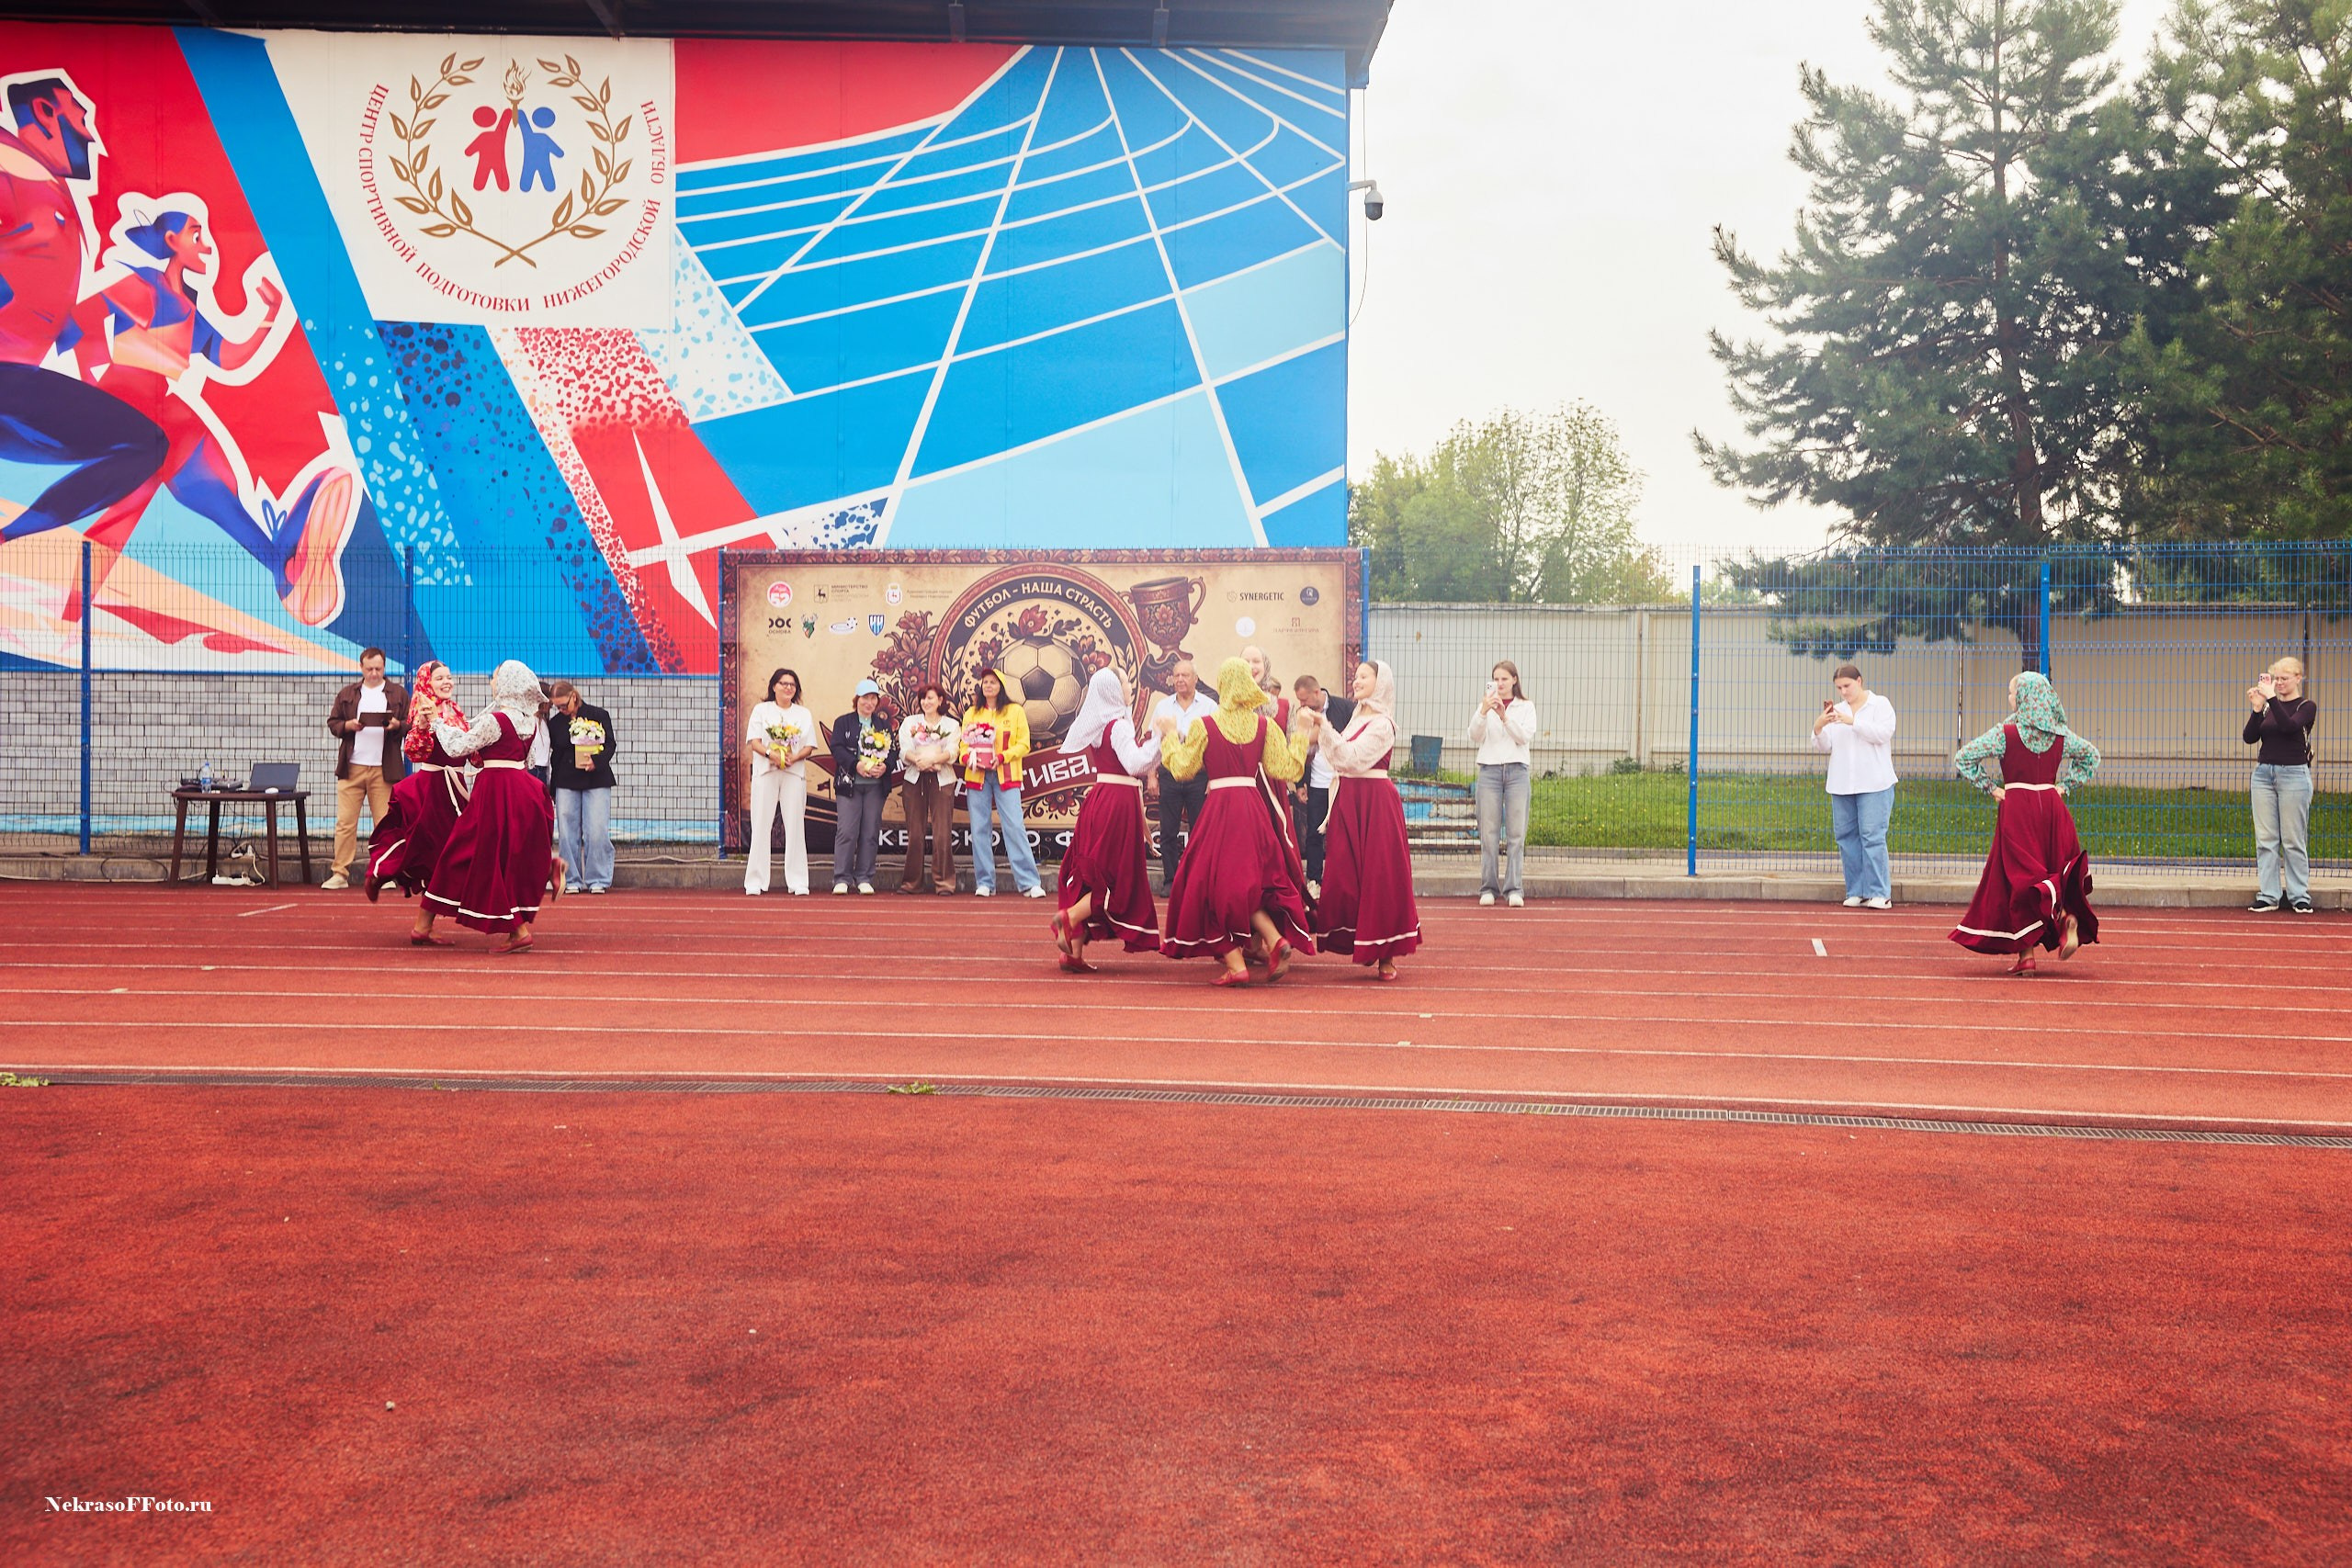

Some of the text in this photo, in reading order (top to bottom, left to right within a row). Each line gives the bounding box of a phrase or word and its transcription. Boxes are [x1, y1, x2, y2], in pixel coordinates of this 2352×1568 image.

[358, 84, 665, 311] ЦЕНТР СПОРТИВНОЙ ПОДГОТОВКИ НИЖЕГОРОДСКОЙ ОБЛАСТИ
[964, 592, 1012, 628] ФУТБОЛ
[1021, 581, 1062, 595] НАША
[1065, 588, 1114, 629] СТРАСТЬ
[1239, 592, 1284, 601] SYNERGETIC
